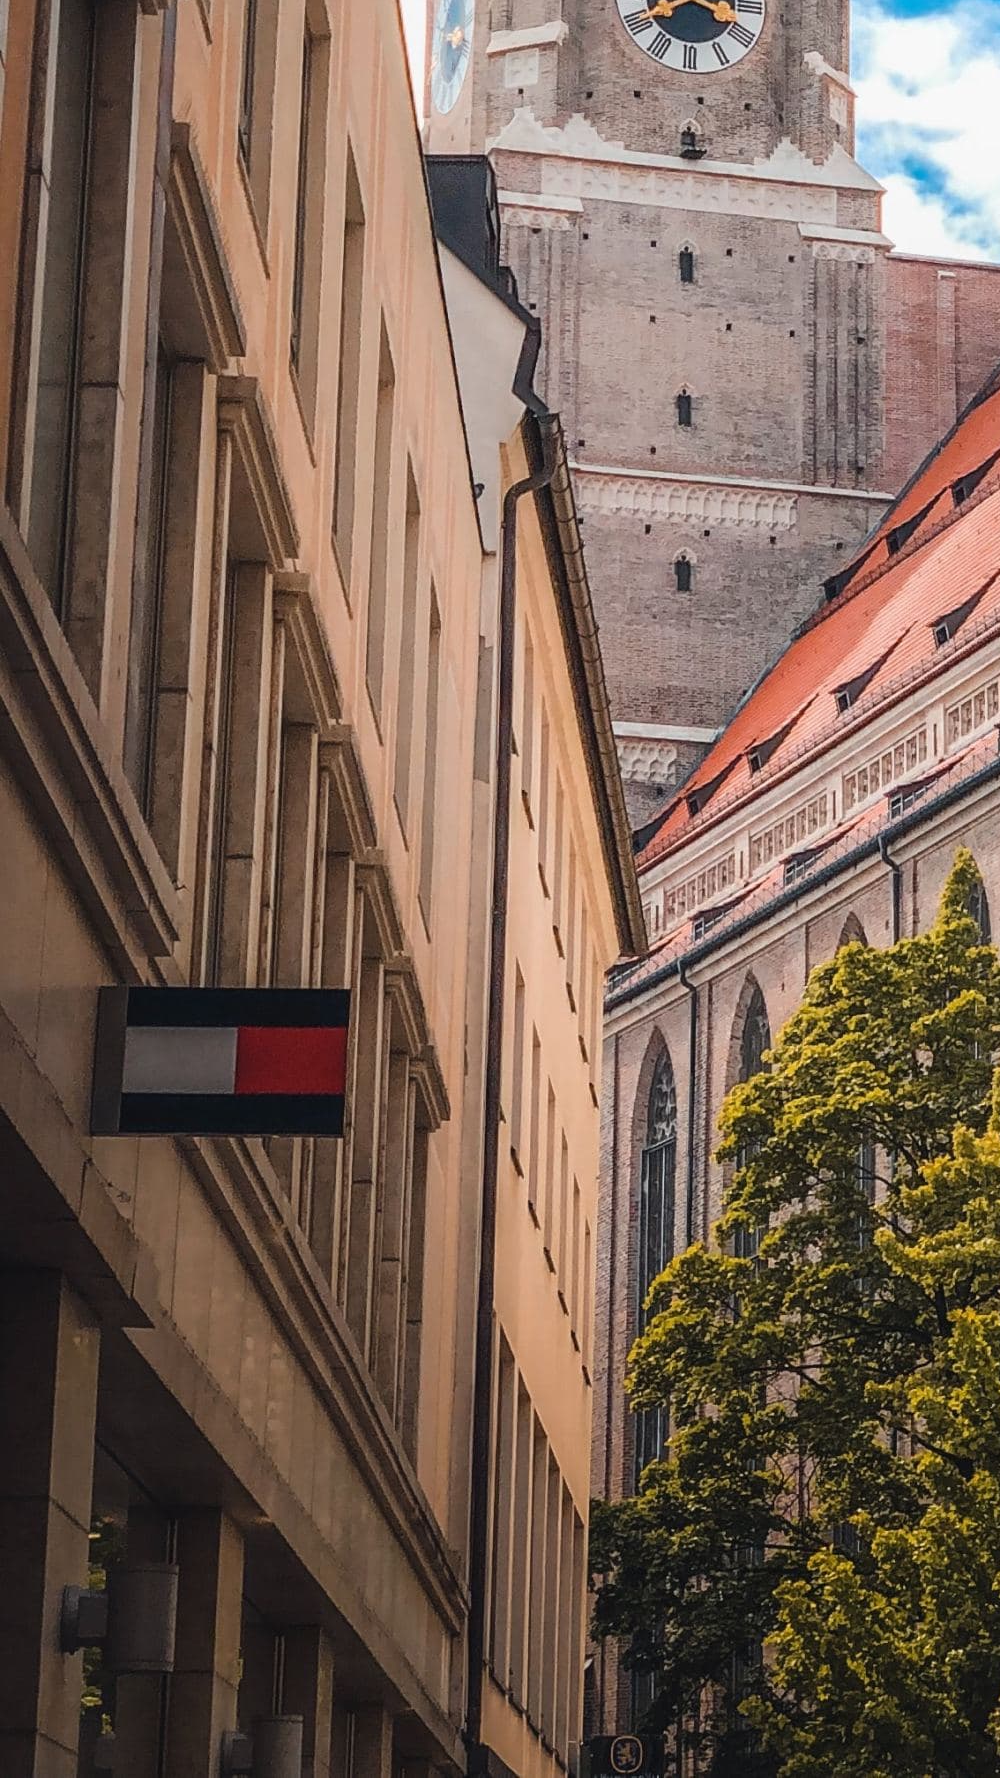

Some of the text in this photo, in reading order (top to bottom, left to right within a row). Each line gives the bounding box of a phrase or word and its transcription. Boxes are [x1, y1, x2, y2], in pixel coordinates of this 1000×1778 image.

[737, 0, 762, 15] III
[647, 30, 672, 60] VII
[683, 44, 698, 70] VI
[712, 41, 730, 65] V
